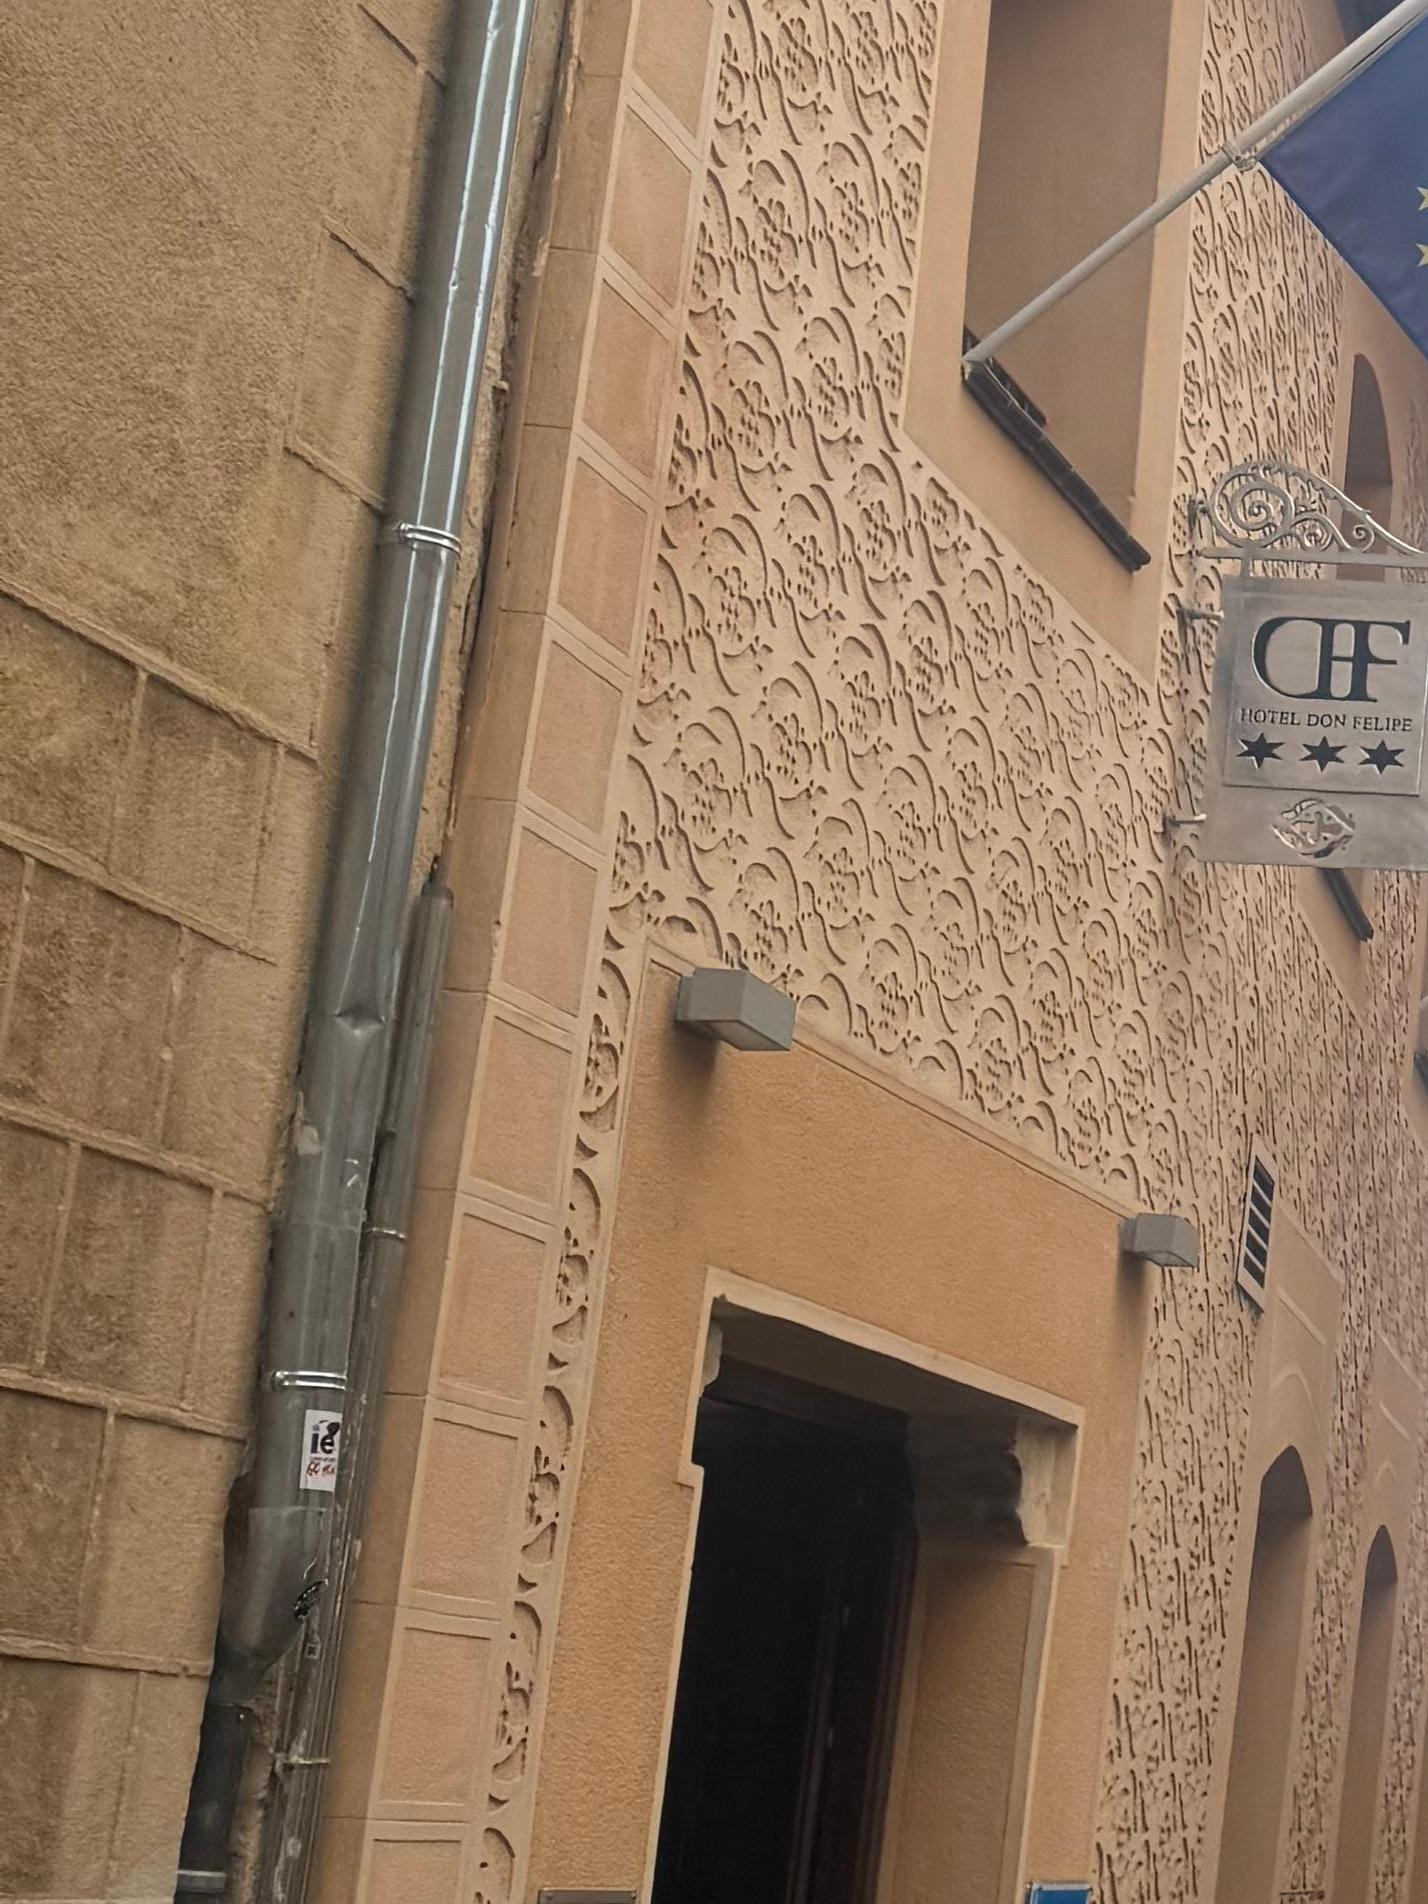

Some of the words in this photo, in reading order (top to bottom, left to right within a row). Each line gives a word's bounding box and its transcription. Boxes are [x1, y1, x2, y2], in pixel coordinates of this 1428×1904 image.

[1240, 707, 1301, 727] HOTEL
[1307, 713, 1347, 728] DON
[1353, 716, 1413, 732] FELIPE
